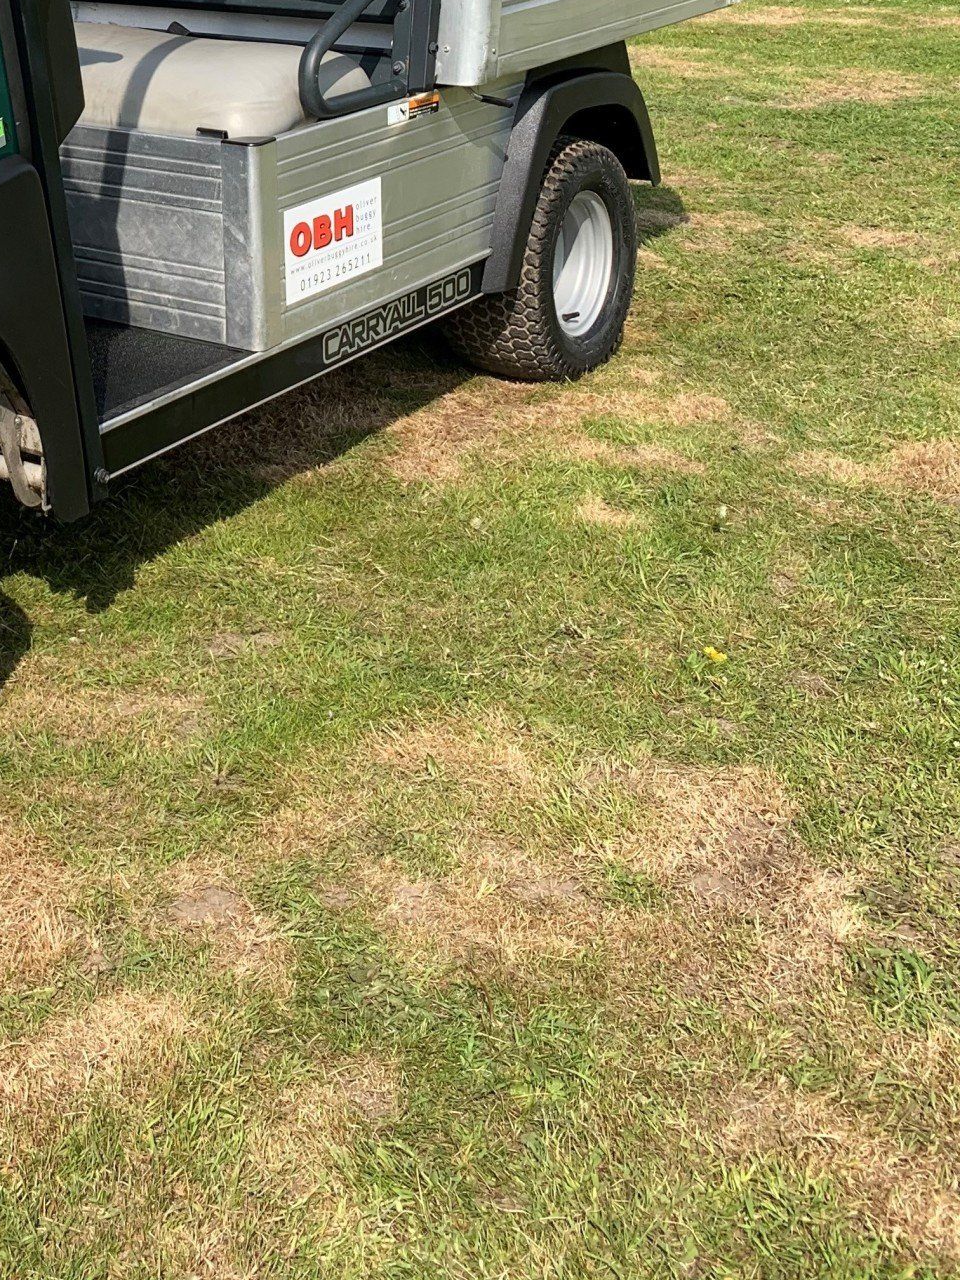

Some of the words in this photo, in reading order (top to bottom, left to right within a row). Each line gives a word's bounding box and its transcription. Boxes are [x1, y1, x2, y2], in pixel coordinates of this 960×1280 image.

[356, 196, 377, 210] oliver
[289, 204, 354, 258] OBH
[355, 211, 377, 224] buggy
[356, 225, 371, 235] hire
[300, 268, 332, 292] 01923
[335, 252, 371, 277] 265211
[322, 291, 426, 365] CARRYALL
[426, 267, 471, 315] 500
